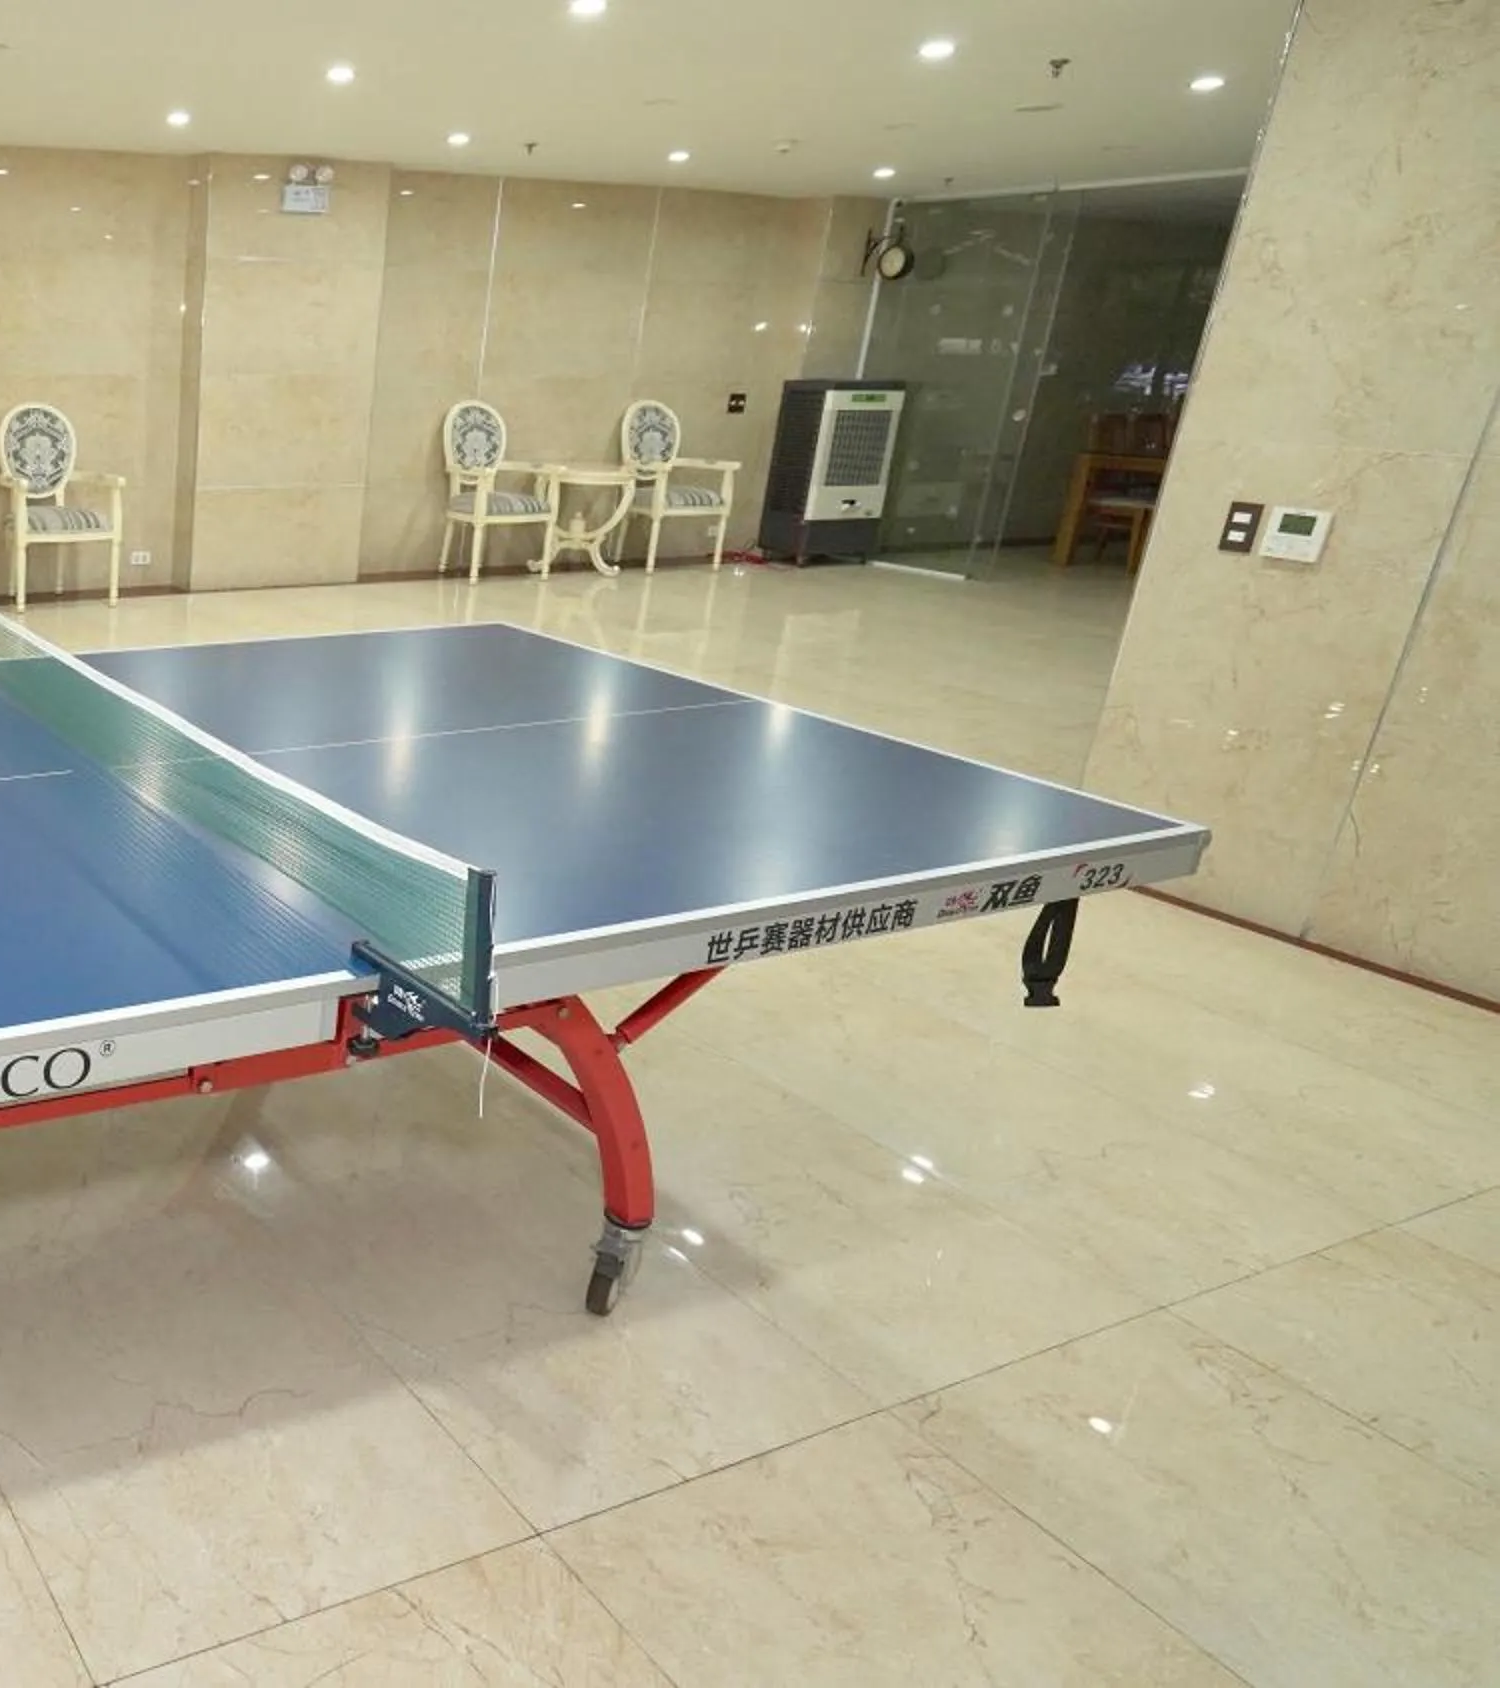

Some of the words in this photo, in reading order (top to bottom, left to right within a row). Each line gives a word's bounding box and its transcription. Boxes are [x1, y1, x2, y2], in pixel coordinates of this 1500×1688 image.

[707, 899, 918, 964] 世乒赛器材供应商
